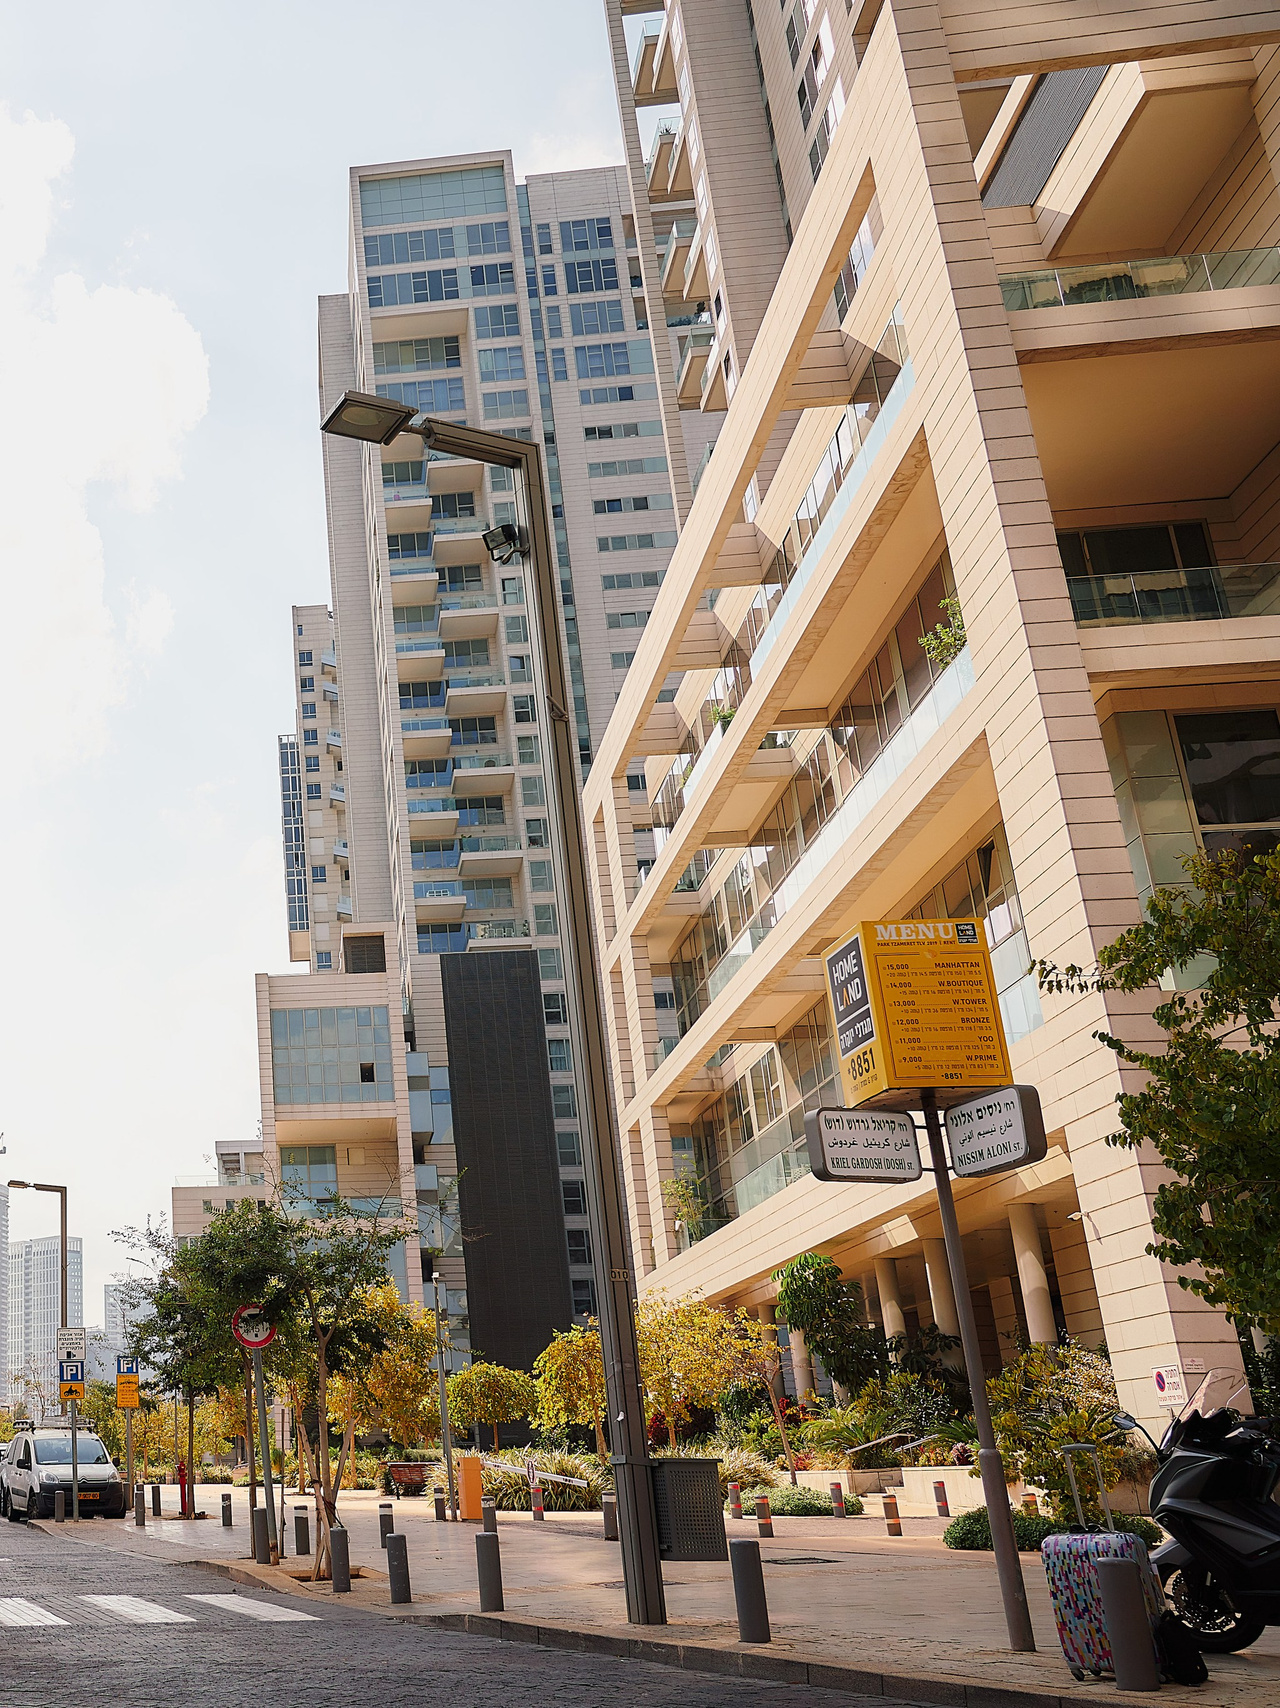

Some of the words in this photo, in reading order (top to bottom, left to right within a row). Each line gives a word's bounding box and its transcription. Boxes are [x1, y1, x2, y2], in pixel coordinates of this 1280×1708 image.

[874, 923, 953, 940] MENU
[832, 950, 859, 987] HOME
[836, 977, 862, 1012] LAND
[855, 1017, 872, 1038] מגדלי
[840, 1028, 855, 1050] יוקרה
[976, 1101, 1002, 1120] ניסים
[1003, 1100, 1015, 1111] רח'
[824, 1115, 844, 1131] (דוש)
[846, 1119, 870, 1130] גרדוש
[870, 1116, 896, 1135] קריאל
[950, 1110, 974, 1127] אלוני
[999, 1118, 1013, 1135] شارع
[828, 1137, 858, 1148] غردوش
[894, 1138, 911, 1151] شارع
[957, 1148, 985, 1167] NISSIM
[986, 1141, 1012, 1159] ALONI
[830, 1157, 851, 1169] KRIEL
[851, 1157, 884, 1170] GARDOSH
[884, 1157, 906, 1171] (DOSH)
[610, 1270, 628, 1279] 010
